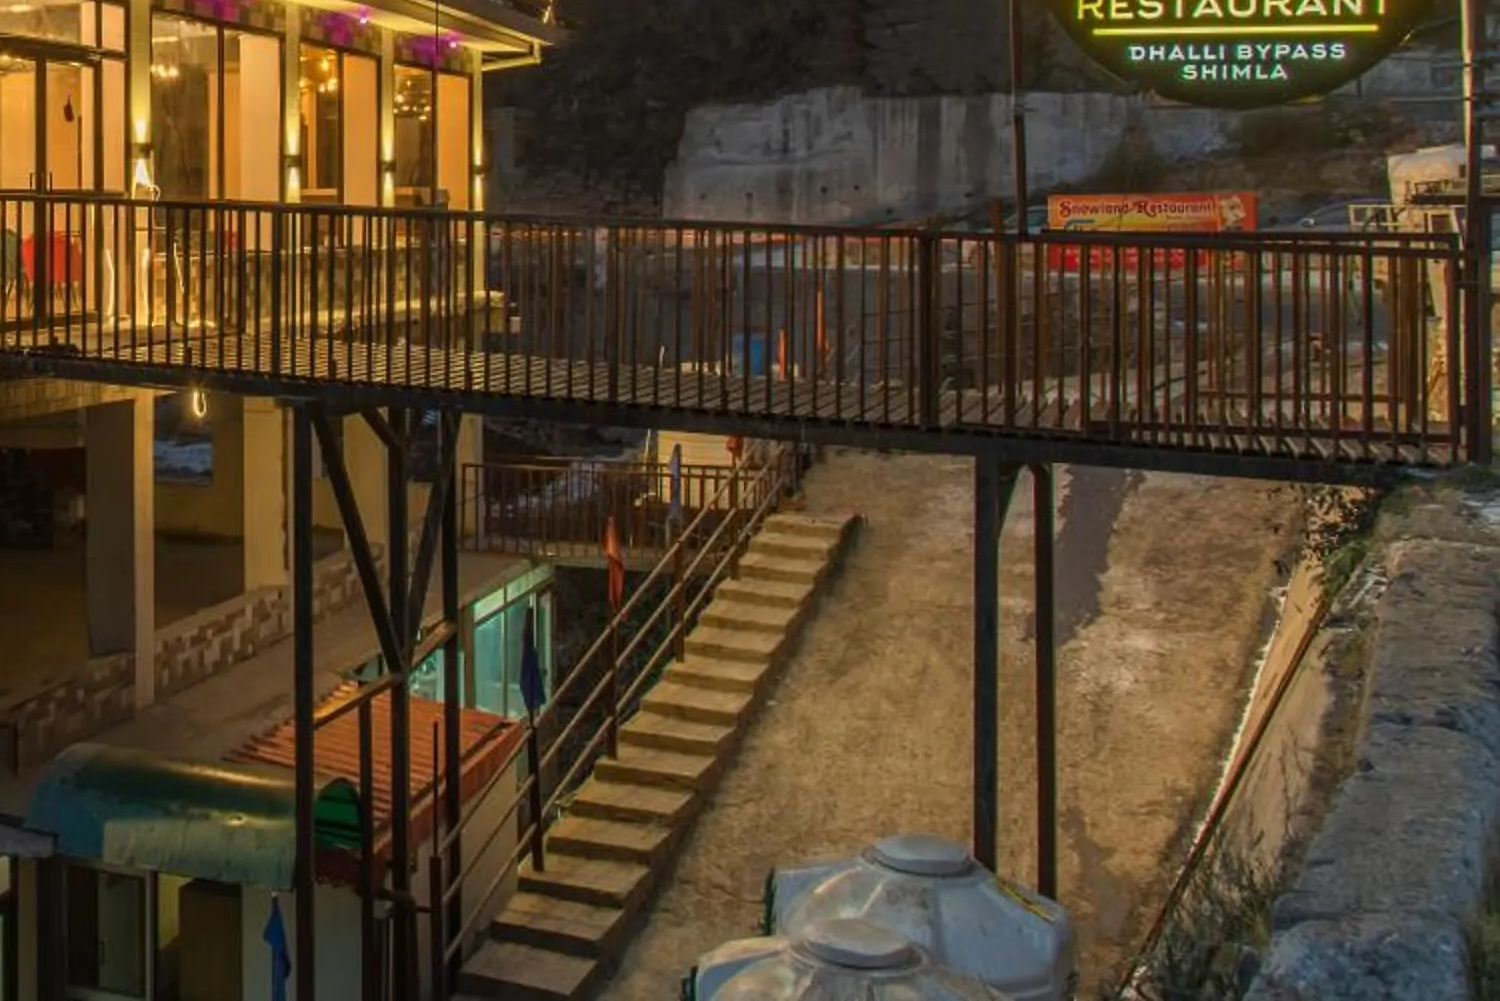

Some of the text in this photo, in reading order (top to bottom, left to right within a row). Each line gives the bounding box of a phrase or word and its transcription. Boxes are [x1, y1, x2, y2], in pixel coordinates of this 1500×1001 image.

[1129, 42, 1347, 61] DHALLI BYPASS
[1182, 63, 1289, 81] SHIMLA
